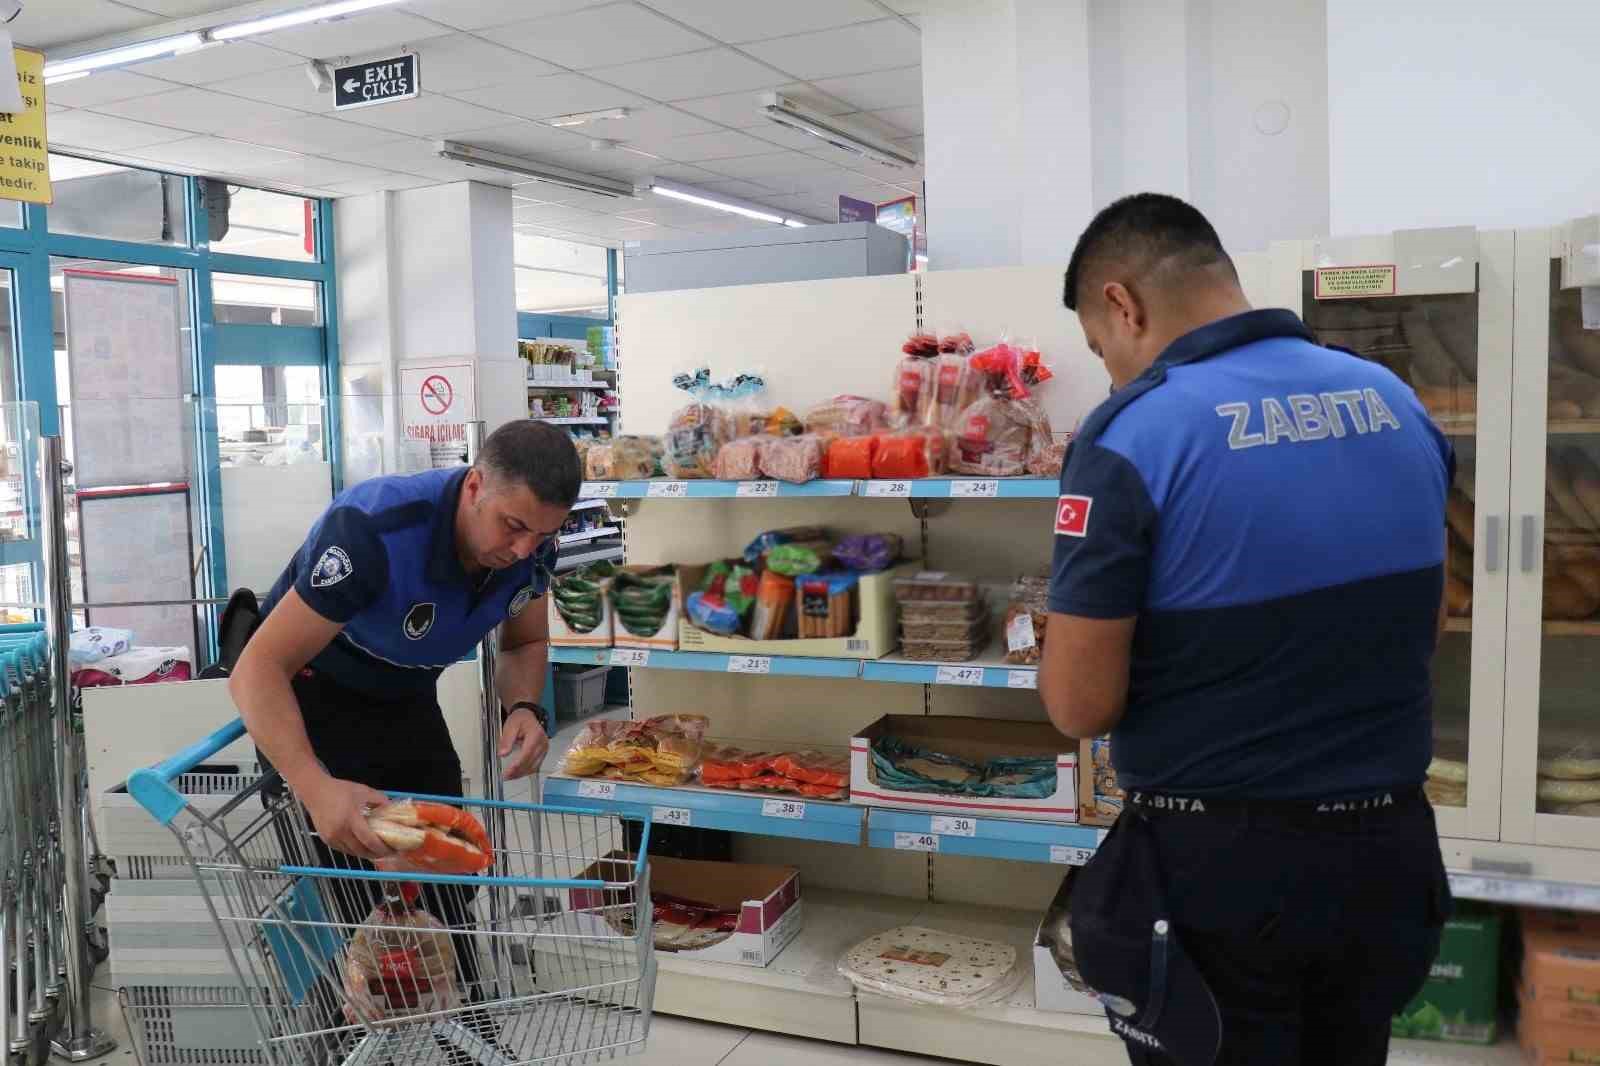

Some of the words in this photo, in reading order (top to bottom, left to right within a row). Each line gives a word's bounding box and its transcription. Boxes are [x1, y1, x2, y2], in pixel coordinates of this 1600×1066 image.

[364, 62, 405, 83] EXIT
[362, 78, 408, 100] ÇIKIŞ
[9, 156, 47, 174] takip
[1215, 388, 1400, 450] ZABITA
[954, 820, 969, 830] 30
